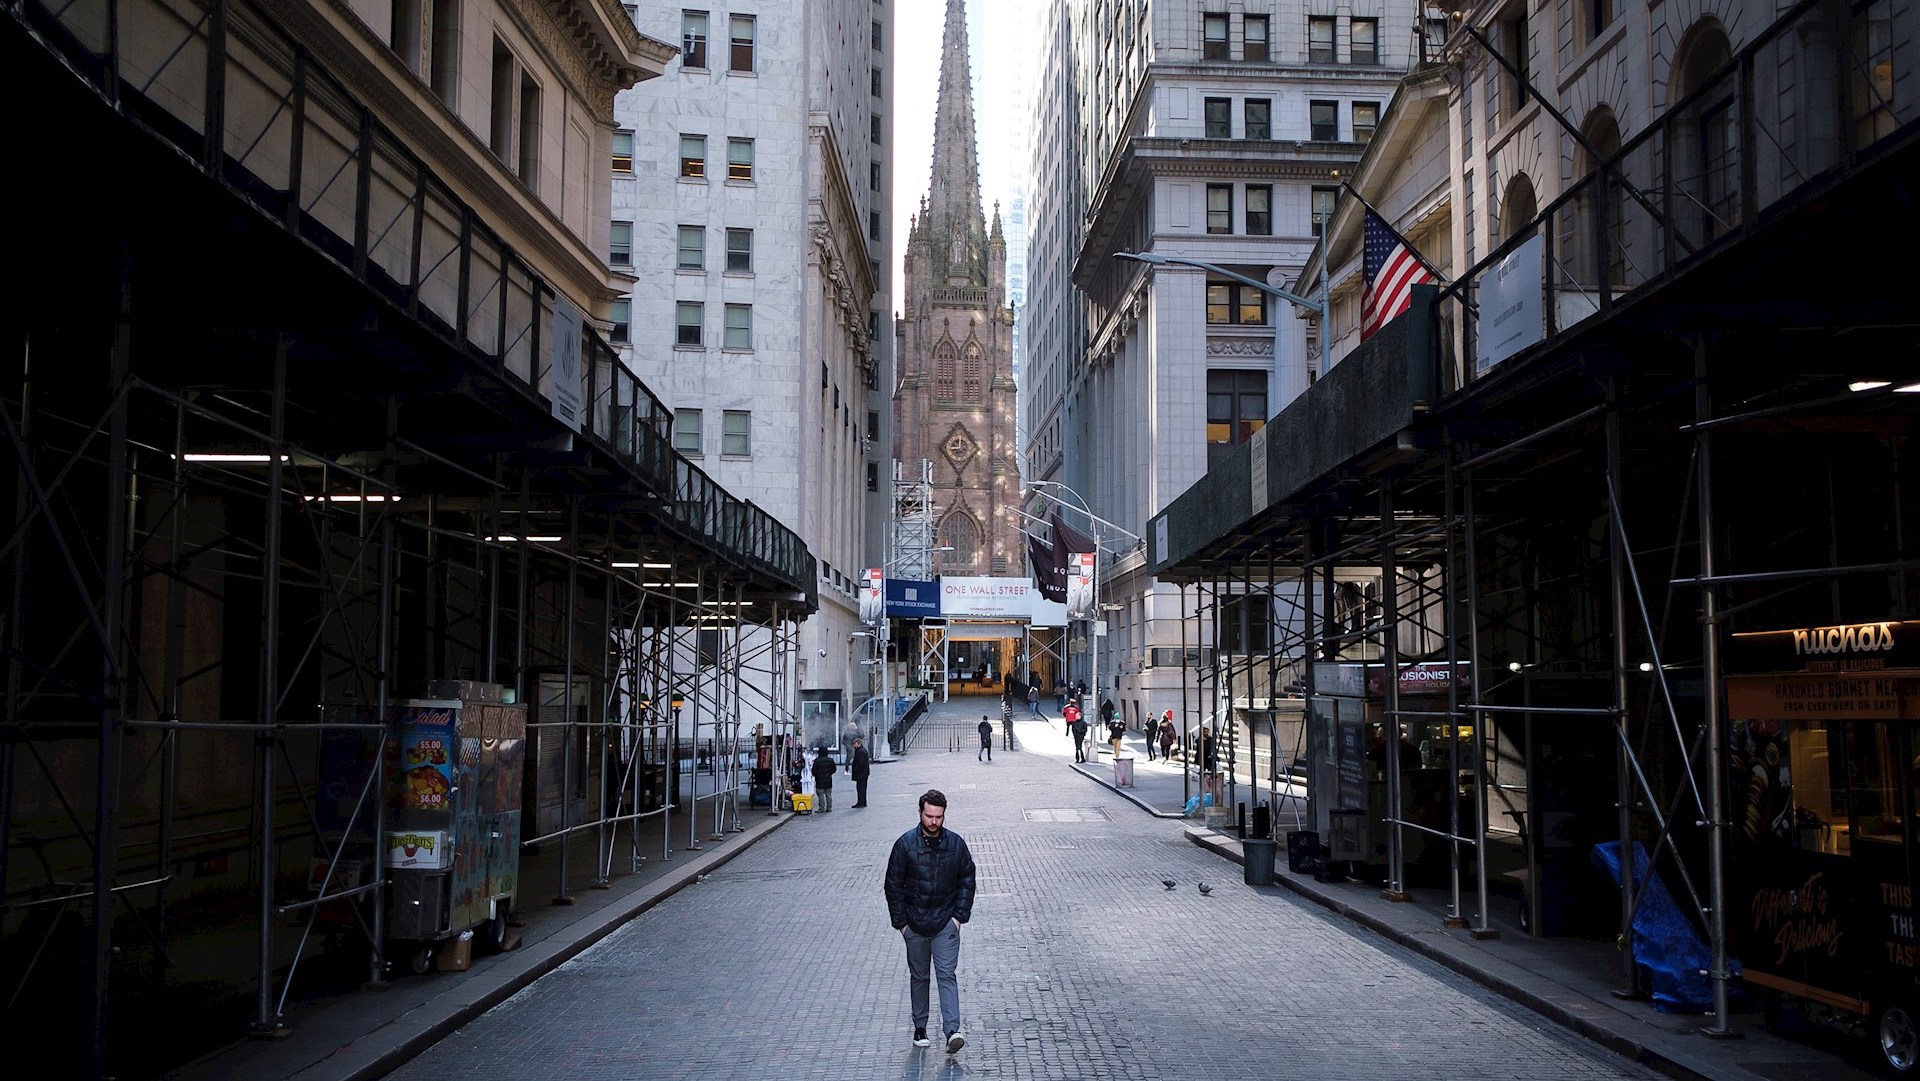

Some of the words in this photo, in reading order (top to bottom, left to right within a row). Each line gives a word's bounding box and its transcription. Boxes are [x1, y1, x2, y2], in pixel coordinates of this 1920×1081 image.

[1053, 566, 1069, 575] EQ
[945, 585, 966, 594] ONE
[970, 585, 995, 595] WALL
[998, 586, 1029, 595] STREET
[1793, 623, 1895, 656] nuchas
[1399, 670, 1450, 681] USIONIST
[1775, 682, 1824, 698] HANDHELD
[1784, 701, 1804, 711] FROM
[1858, 700, 1869, 711] ON
[420, 740, 441, 749] $5.00
[420, 794, 441, 803] $6.00
[1879, 882, 1913, 909] THIS
